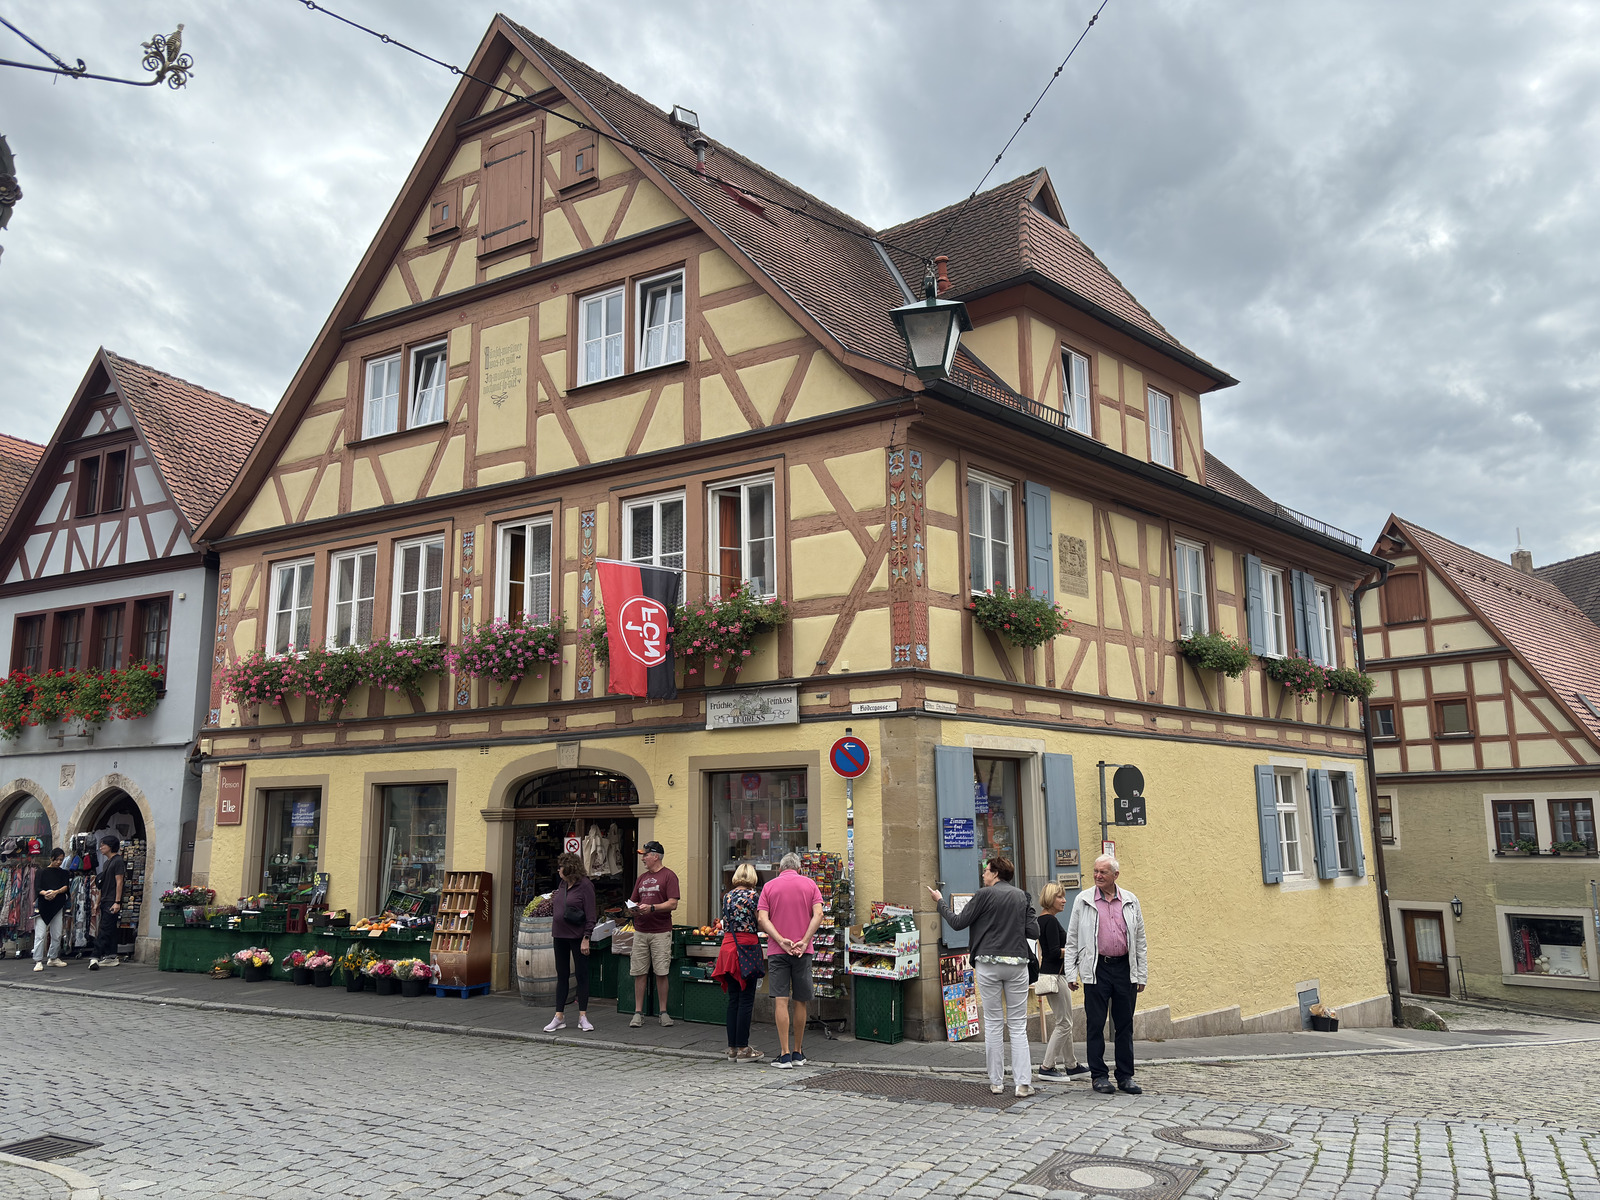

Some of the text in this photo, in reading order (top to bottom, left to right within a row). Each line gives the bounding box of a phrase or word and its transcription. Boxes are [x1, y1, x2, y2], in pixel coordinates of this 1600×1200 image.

[766, 696, 793, 705] Feinkost
[733, 714, 766, 724] ENDRESS
[113, 761, 118, 769] 8
[221, 776, 239, 789] Pension
[667, 773, 674, 787] 6
[221, 800, 236, 813] Elke
[20, 810, 44, 820] Boutique
